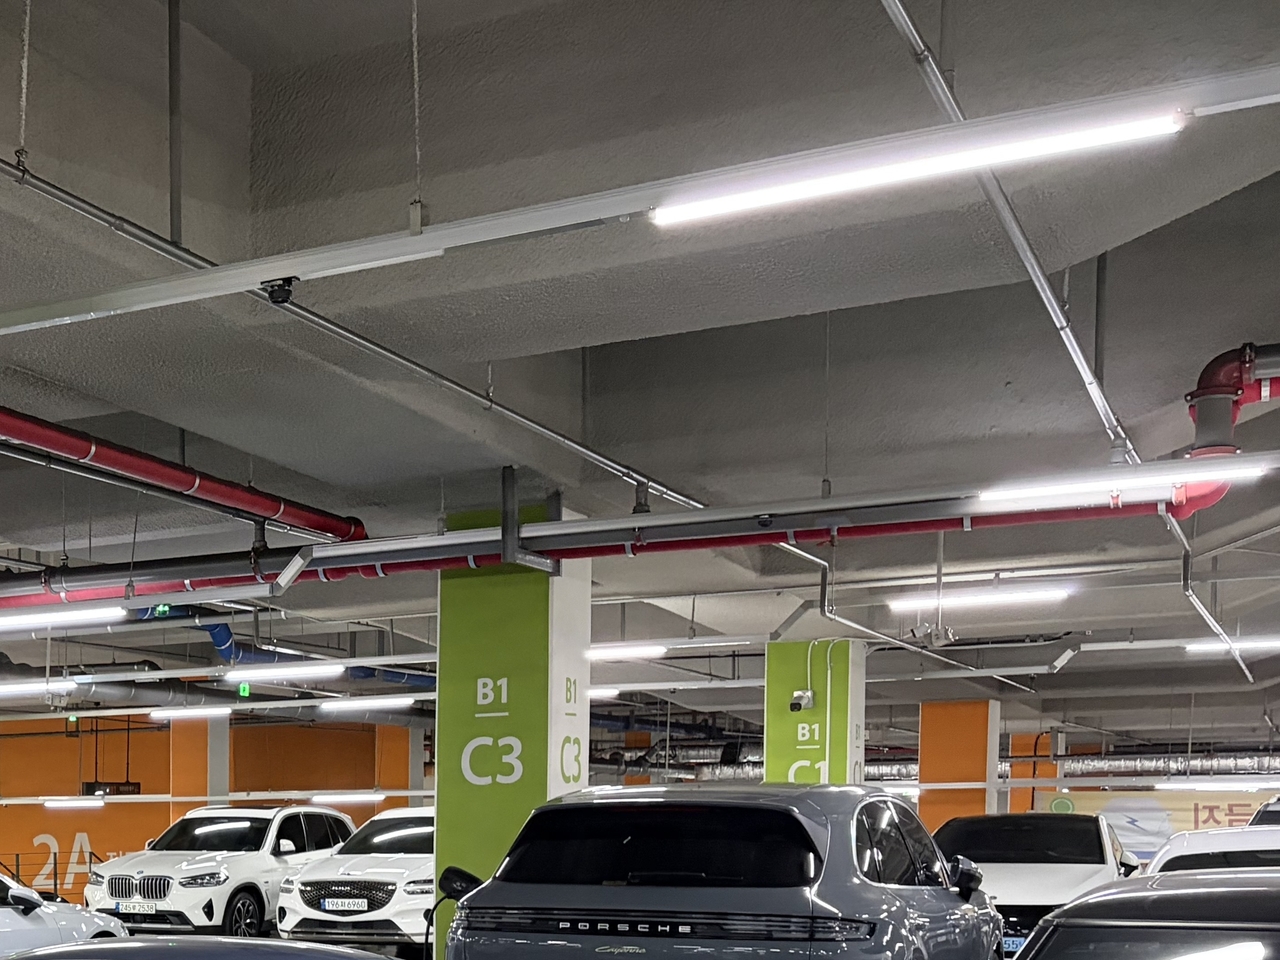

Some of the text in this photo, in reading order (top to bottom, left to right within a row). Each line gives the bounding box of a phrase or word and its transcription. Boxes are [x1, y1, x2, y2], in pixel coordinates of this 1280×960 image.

[477, 677, 508, 705] B1
[565, 677, 577, 704] B1
[797, 723, 820, 741] B1
[461, 736, 524, 785] C3
[560, 736, 581, 784] C3
[788, 760, 827, 784] C1
[32, 832, 94, 889] 2A
[137, 904, 154, 913] 2538
[346, 900, 366, 909] 6960
[559, 922, 691, 933] PORSCHE
[1004, 940, 1024, 949] 55
